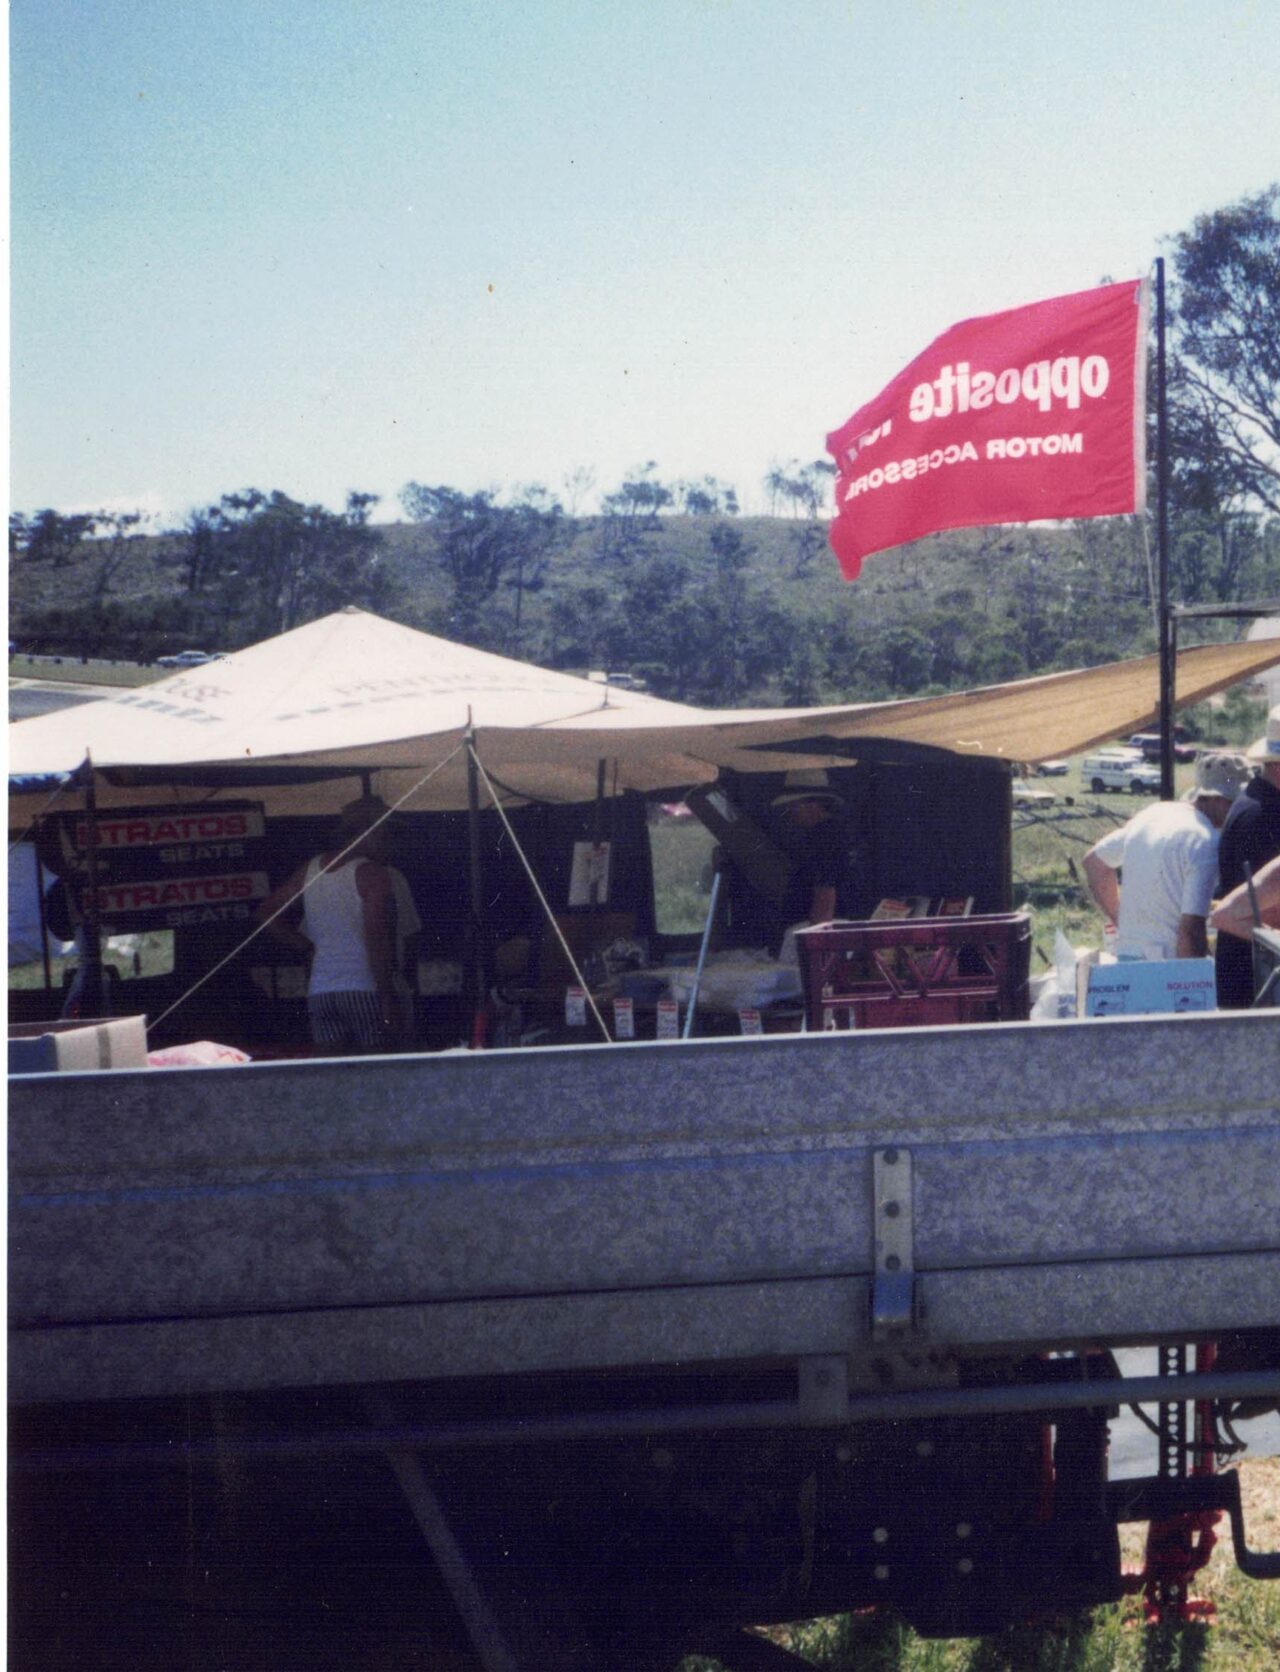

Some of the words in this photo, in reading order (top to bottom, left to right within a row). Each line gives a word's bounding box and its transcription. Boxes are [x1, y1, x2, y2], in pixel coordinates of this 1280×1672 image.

[159, 842, 245, 864] SEATS
[166, 904, 250, 926] SEATS
[1166, 981, 1213, 991] SOLUTION
